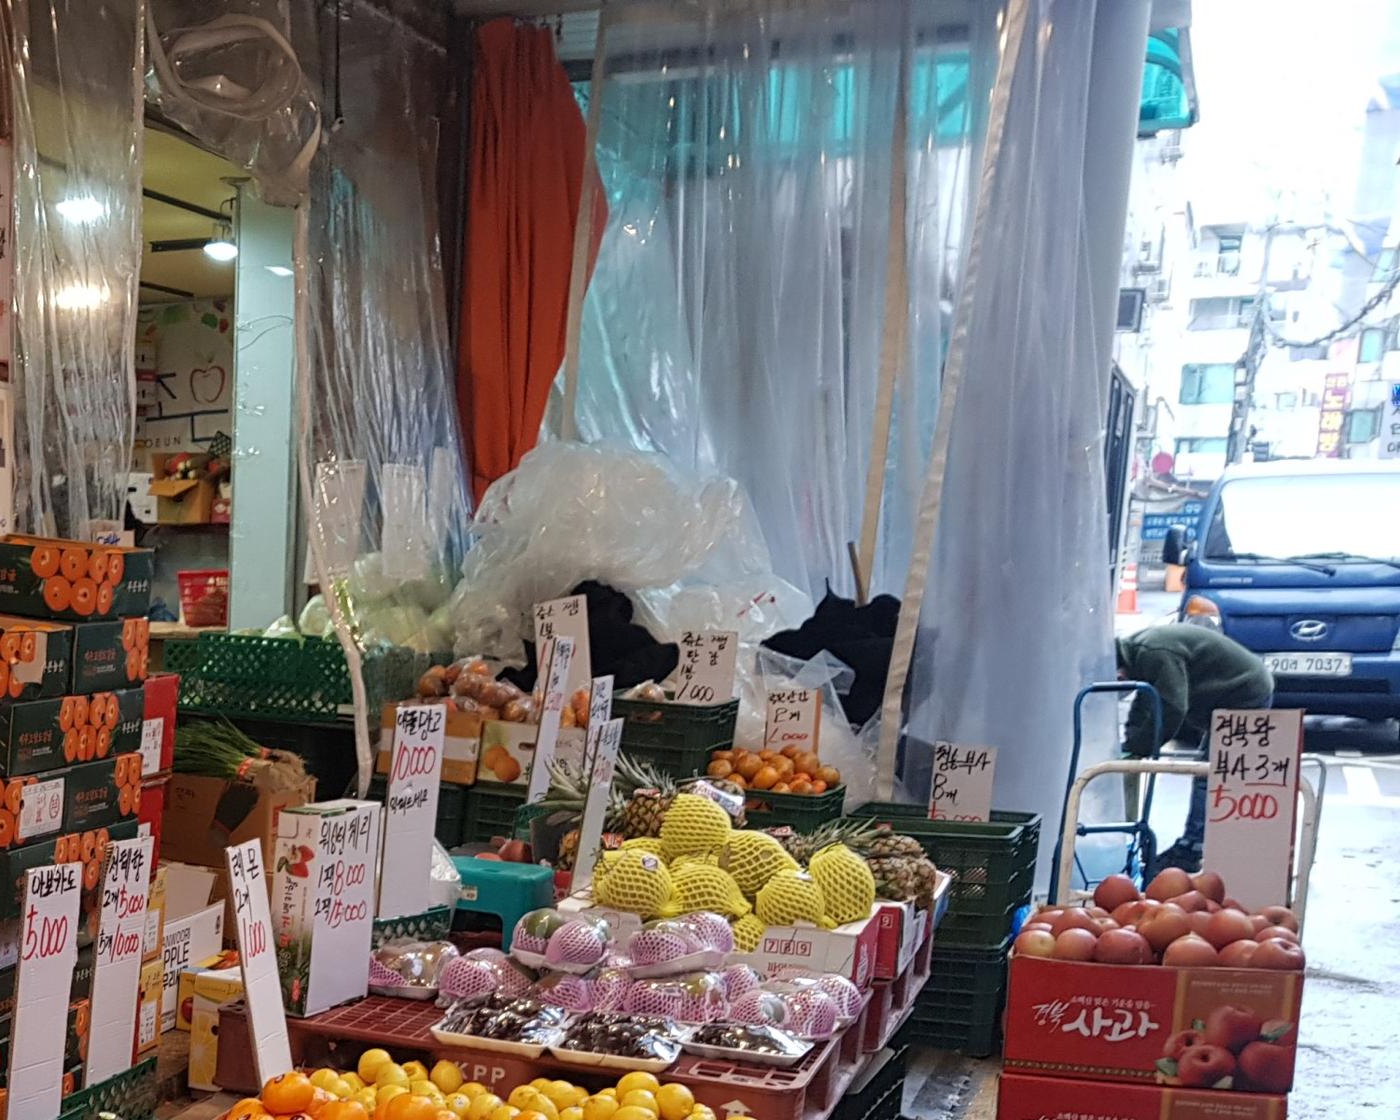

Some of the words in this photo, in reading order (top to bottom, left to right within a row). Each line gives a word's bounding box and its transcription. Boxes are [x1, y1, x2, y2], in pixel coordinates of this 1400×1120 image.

[1305, 658, 1344, 672] 7037
[1215, 714, 1276, 748] 경북왕
[163, 941, 191, 971] PPLE
[1062, 1004, 1159, 1043] 사과
